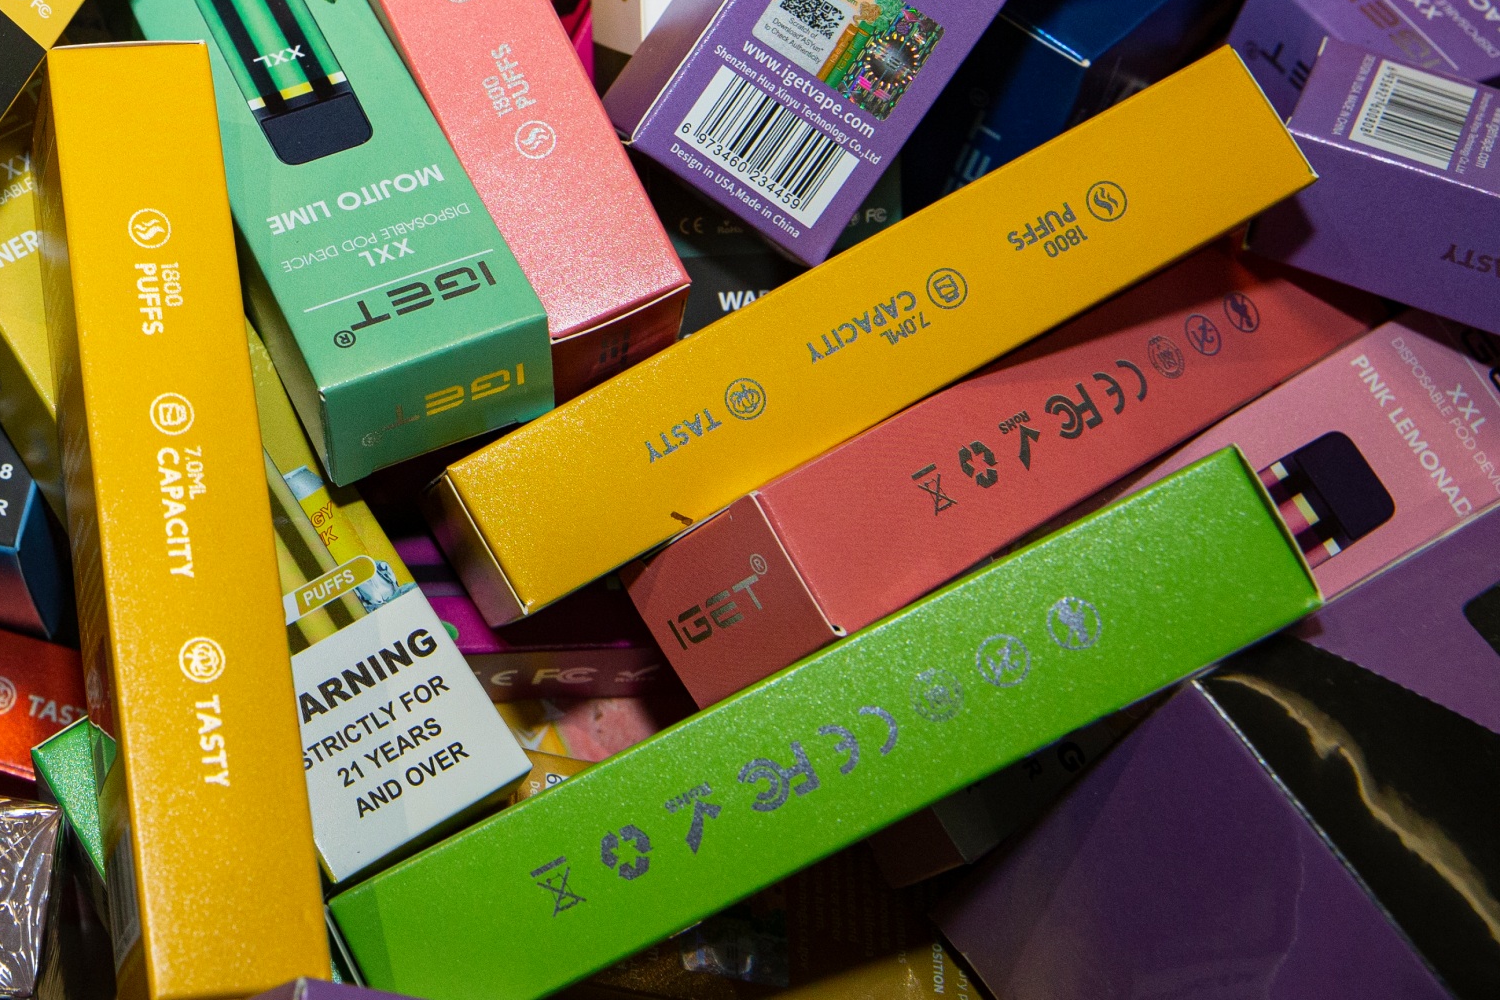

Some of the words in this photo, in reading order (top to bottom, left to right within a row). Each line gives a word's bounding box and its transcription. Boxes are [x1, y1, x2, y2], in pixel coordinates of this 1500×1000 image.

[253, 44, 306, 68] XXL
[491, 43, 535, 110] PUFFS
[714, 44, 758, 79] Shenzhen
[774, 85, 802, 111] Xinyu
[801, 104, 851, 146] Technology
[742, 40, 875, 138] www.igetvape.com
[266, 199, 333, 236] LIME
[337, 164, 445, 213] MOJITO
[669, 142, 703, 171] Design
[772, 213, 801, 239] China
[345, 229, 378, 254] POD
[358, 237, 415, 267] XXL
[382, 203, 470, 239] DISPOSABLE
[1007, 202, 1076, 252] PUFFS
[1044, 224, 1088, 258] 1800
[161, 262, 183, 307] 1800
[281, 242, 338, 273] DEVICE
[135, 263, 163, 335] PUFFS
[805, 290, 917, 365] CAPACITY
[999, 410, 1029, 435] RoHS
[1391, 337, 1451, 416] DISPOSABLE
[1449, 418, 1476, 450] POD
[1447, 384, 1486, 434] XXL
[644, 407, 722, 464] TASTY
[1351, 354, 1395, 407] PINK
[1388, 407, 1472, 517] LEMONAD
[157, 447, 195, 579] CAPACITY
[303, 569, 355, 607] PUFFS
[298, 628, 438, 724] ARNING
[195, 694, 230, 787] TASTY
[303, 701, 397, 771] STRICTLY
[399, 675, 450, 713] FOR
[337, 761, 365, 787] 21
[364, 718, 442, 770] YEARS
[356, 778, 402, 818] AND
[405, 741, 470, 787] OVER
